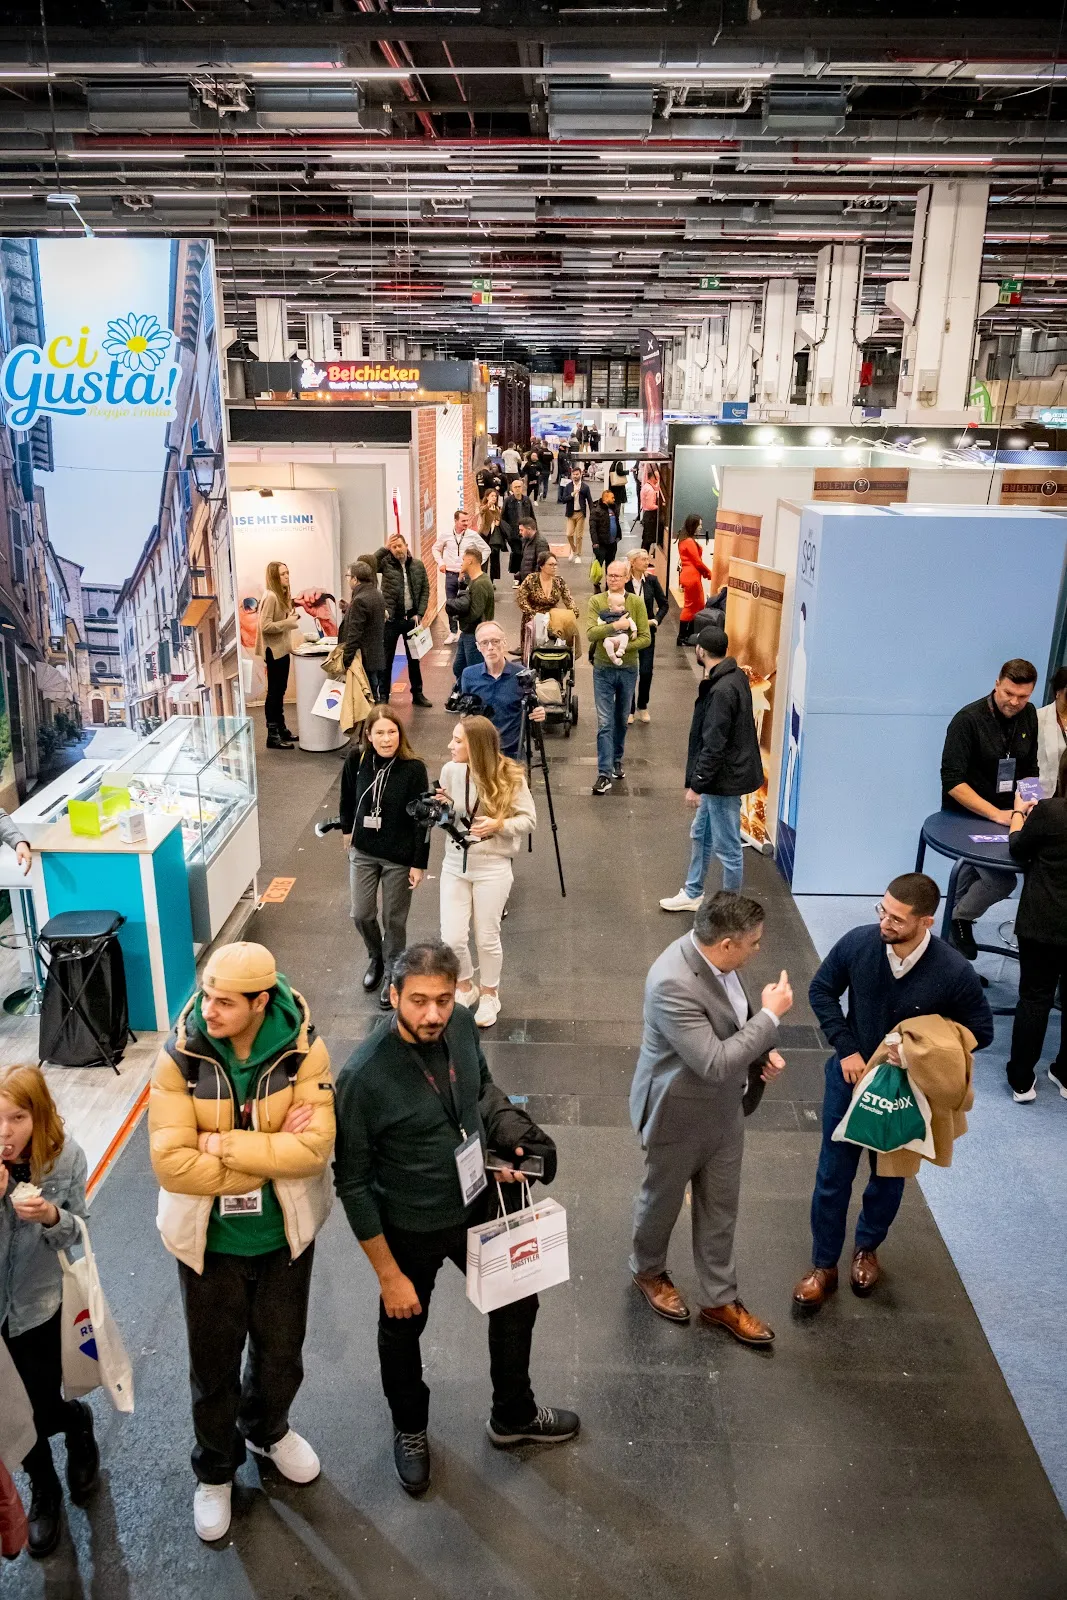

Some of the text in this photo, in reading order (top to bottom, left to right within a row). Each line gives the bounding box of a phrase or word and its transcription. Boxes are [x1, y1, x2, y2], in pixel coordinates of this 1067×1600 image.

[48, 326, 98, 368] ci
[328, 365, 420, 381] Belchicken
[5, 349, 178, 426] Gusta!
[256, 516, 278, 524] MIT
[280, 515, 313, 523] SINN!
[511, 1254, 539, 1270] DOGSTYLER
